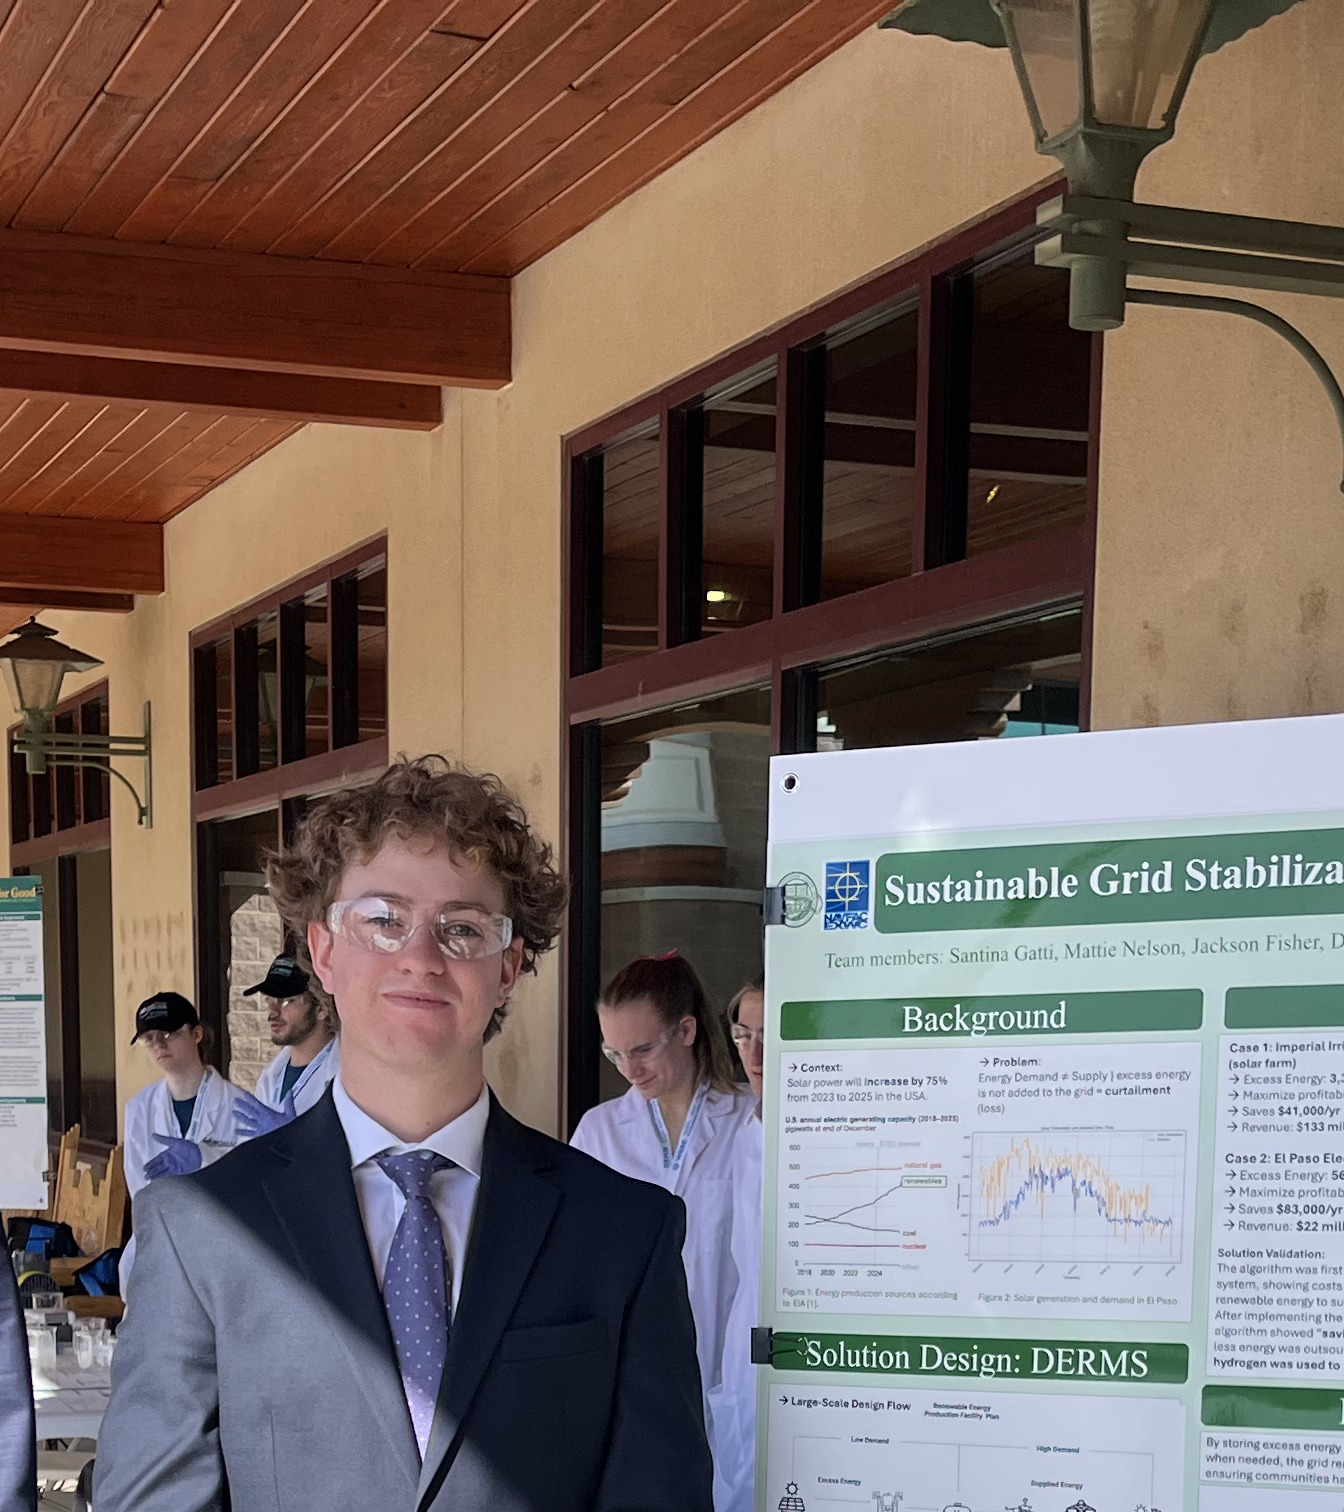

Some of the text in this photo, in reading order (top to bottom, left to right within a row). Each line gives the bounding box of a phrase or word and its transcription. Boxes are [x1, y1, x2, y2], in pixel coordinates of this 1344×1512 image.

[11, 886, 36, 899] Good
[885, 866, 1078, 906] Sustainable
[1090, 860, 1172, 896] Grid
[825, 952, 864, 968] Team
[871, 949, 944, 967] members:
[950, 946, 1008, 964] Santina
[1015, 945, 1058, 962] Gatti,
[1065, 943, 1116, 959] Mattie
[1123, 939, 1185, 957] Nelson,
[1192, 936, 1258, 954] Jackson
[1266, 933, 1323, 952] Fisher,
[901, 1001, 1067, 1038] Background
[805, 1340, 1149, 1379] Solution Design: DERMS
